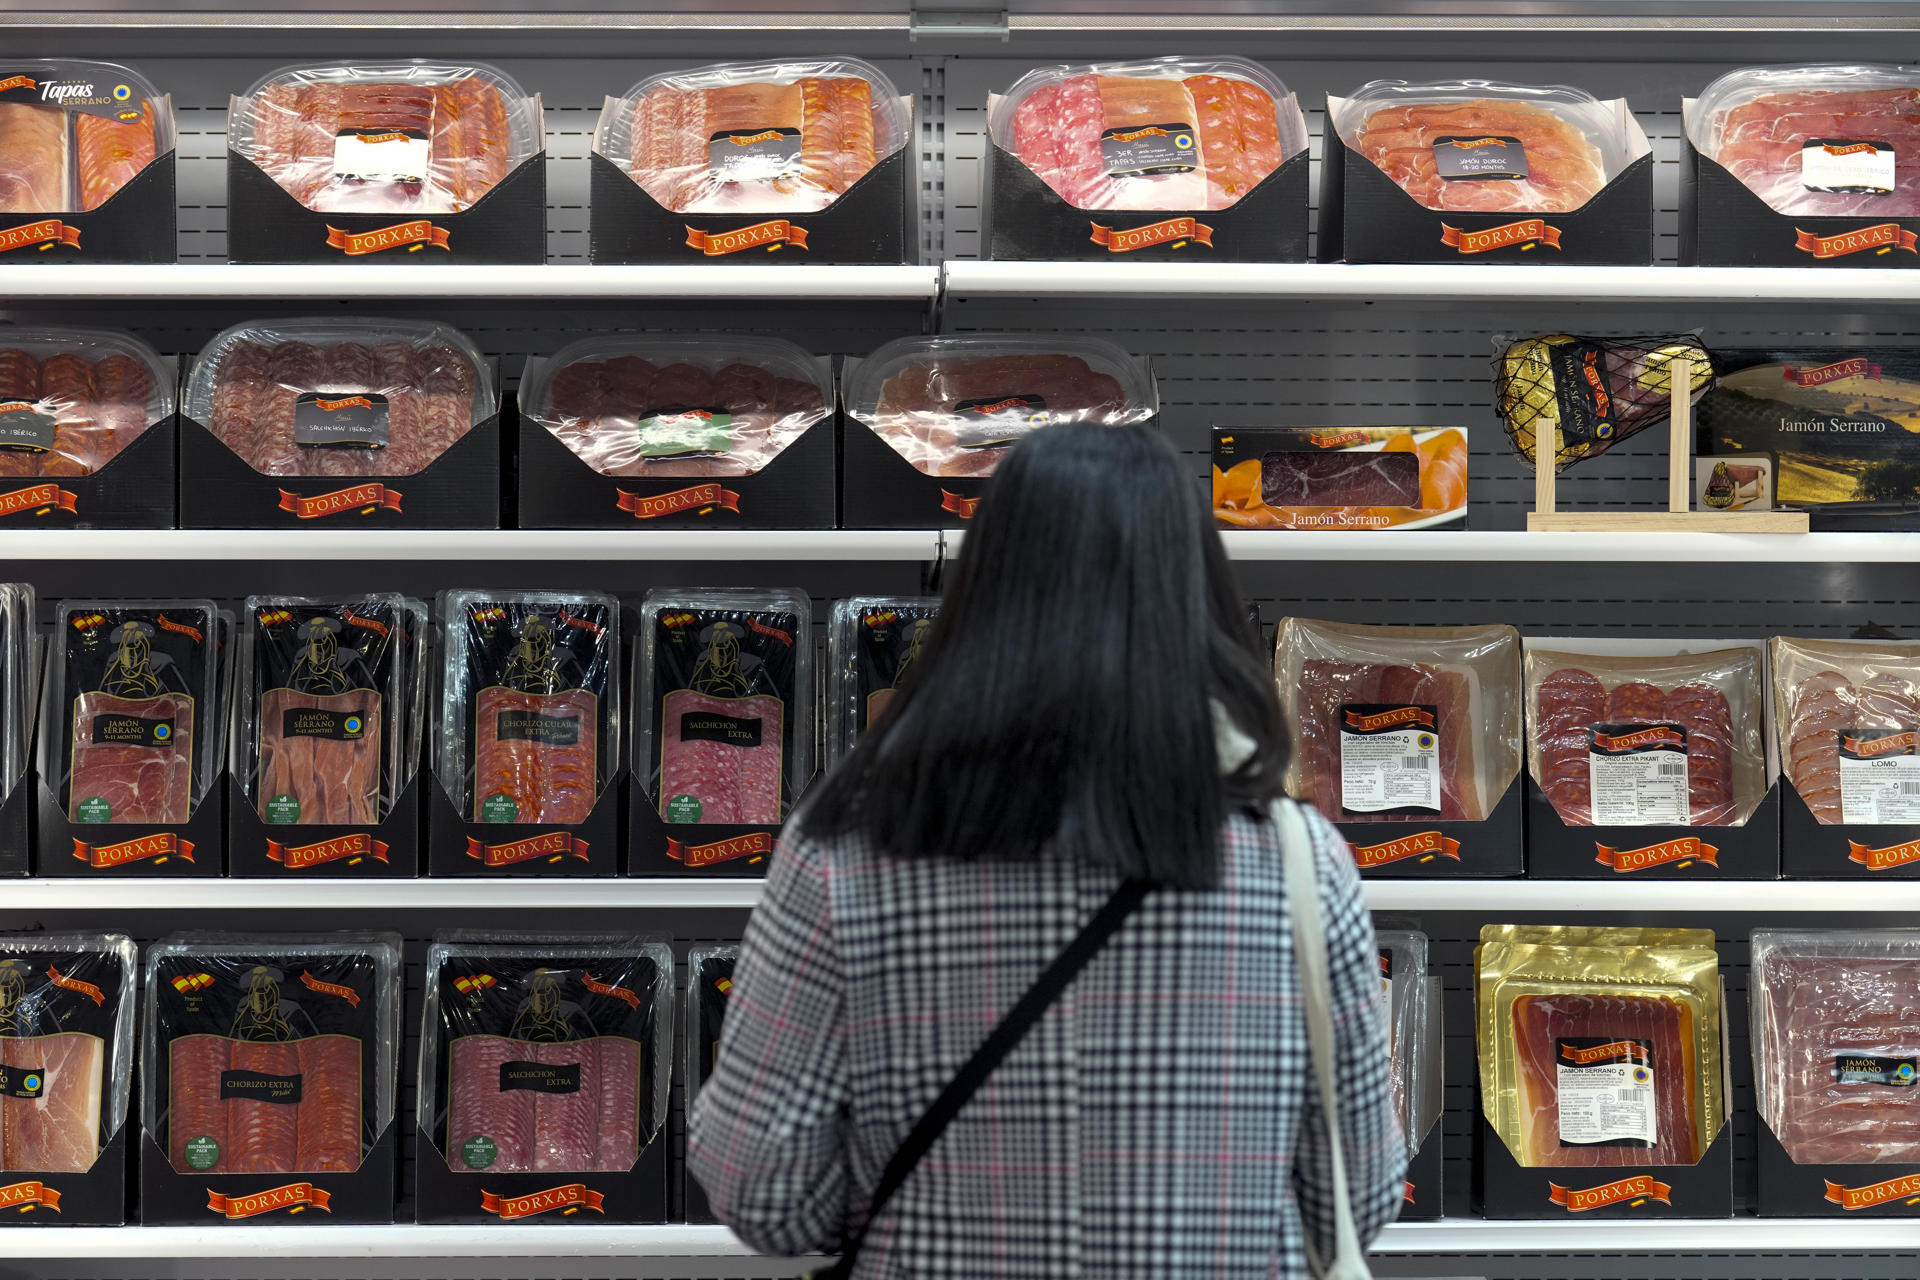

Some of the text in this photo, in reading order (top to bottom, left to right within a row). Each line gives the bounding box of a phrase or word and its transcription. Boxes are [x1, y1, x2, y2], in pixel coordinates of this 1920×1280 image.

[39, 80, 94, 104] Tapas
[63, 97, 111, 106] SERRANO
[368, 133, 399, 142] PORXAS
[740, 133, 773, 145] PORXAS
[1125, 128, 1156, 141] PORXAS
[1465, 138, 1494, 148] PORXAS
[1835, 145, 1866, 154] PORXAS
[1109, 158, 1136, 166] TAPAS
[353, 225, 424, 250] PORXAS
[712, 224, 783, 250] PORXAS
[1117, 222, 1188, 247] PORXAS
[1467, 223, 1537, 249] PORXAS
[1822, 228, 1893, 253] PORXAS
[1804, 362, 1862, 384] PORXAS
[1586, 366, 1606, 404] PORXAS
[328, 399, 360, 410] PORXAS
[984, 400, 1017, 413] PORXAS
[1778, 417, 1886, 432] Jamón Serrano
[1323, 433, 1358, 446] PORXAS
[0, 488, 51, 509] RXAS
[305, 487, 377, 513] PORXAS
[642, 488, 714, 513] PORXAS
[1291, 512, 1390, 526] Jamón Serrano
[166, 623, 195, 634] PORXAS
[109, 719, 139, 727] JAMÓN
[294, 720, 335, 728] SERRANO
[545, 720, 572, 728] CULAR
[689, 720, 738, 729] SALCHICHÓN
[1364, 710, 1416, 728] PORXAS
[103, 726, 144, 734] SERRANO
[525, 728, 549, 736] EXTRA
[728, 731, 753, 739] EXTRA
[1613, 730, 1665, 748] PORXAS
[1862, 734, 1913, 754] PORXAS
[99, 838, 169, 863] PORXAS
[292, 838, 363, 864] PORXAS
[492, 836, 563, 861] PORXAS
[692, 837, 763, 862] PORXAS
[1363, 835, 1435, 862] PORXAS
[1622, 841, 1693, 867] PORXAS
[311, 983, 350, 997] PORXAS
[1580, 1043, 1631, 1061] PORXAS
[1846, 1058, 1876, 1067] JAMÓN
[226, 1080, 267, 1088] CHORIZO
[546, 1078, 572, 1086] EXTRA
[234, 1186, 305, 1213] PORXAS
[1575, 1179, 1646, 1206] PORXAS
[507, 1188, 578, 1214] PORXAS
